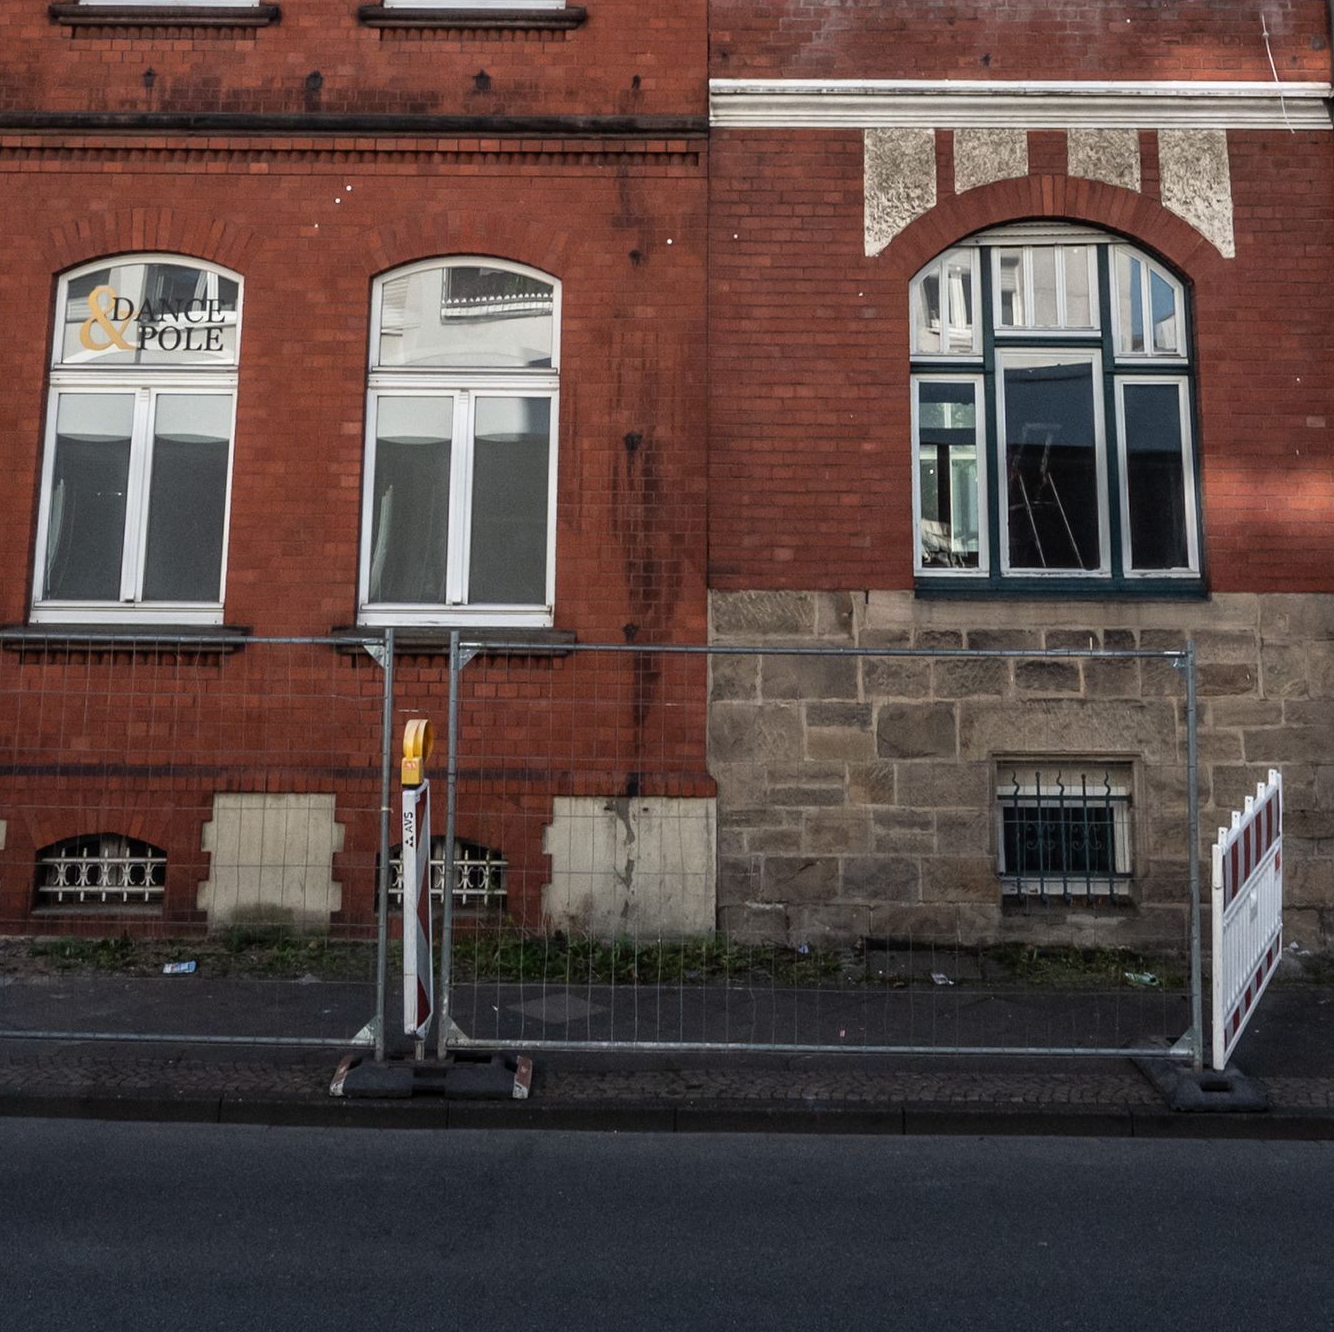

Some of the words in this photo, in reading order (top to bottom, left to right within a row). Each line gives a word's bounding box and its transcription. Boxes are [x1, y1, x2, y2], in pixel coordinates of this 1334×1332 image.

[80, 285, 138, 351] &
[112, 297, 226, 324] DANCE
[137, 325, 224, 352] POLE
[404, 811, 413, 833] AVS
